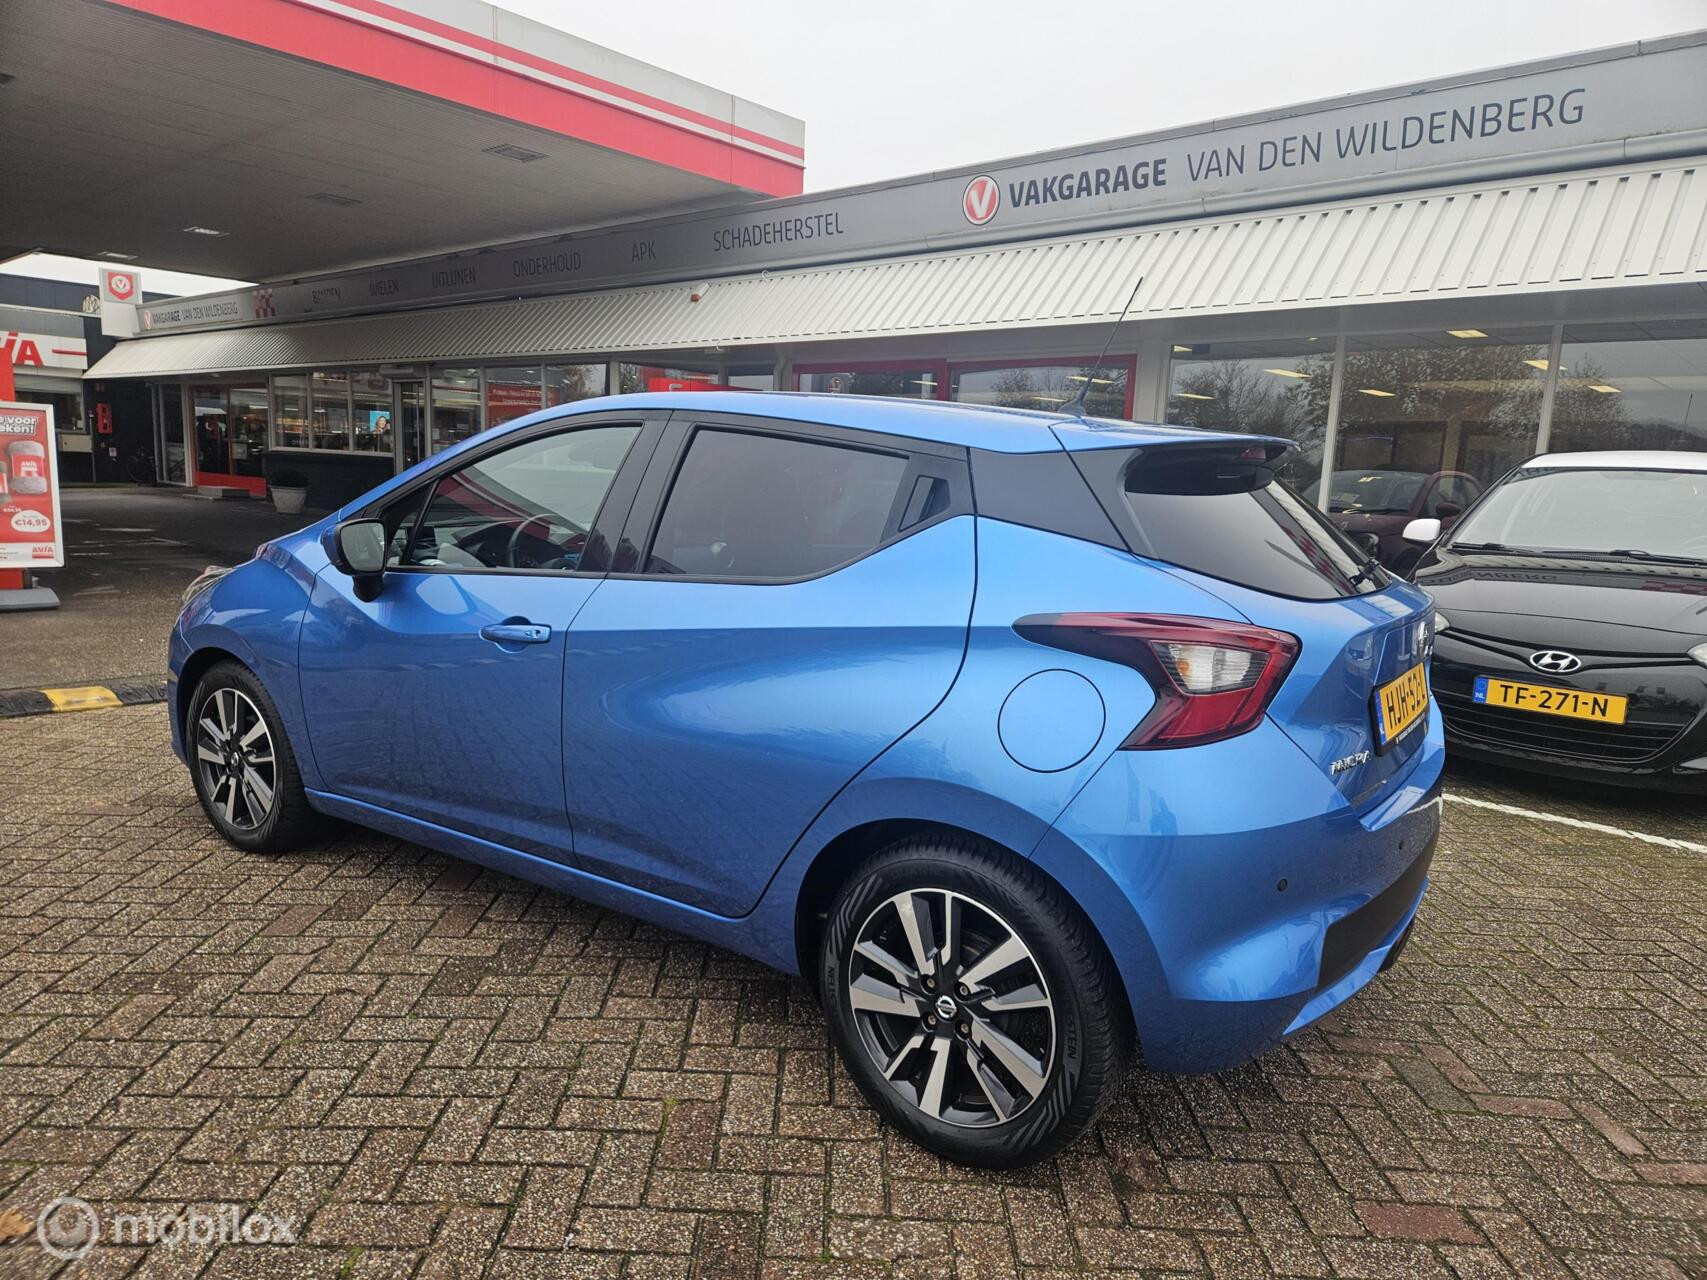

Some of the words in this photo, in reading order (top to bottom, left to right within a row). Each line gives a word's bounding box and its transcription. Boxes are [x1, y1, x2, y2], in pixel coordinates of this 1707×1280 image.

[1009, 158, 1168, 208] VAKGARAGE
[1187, 144, 1245, 182] VAN
[1258, 131, 1323, 172] DEN
[1336, 88, 1587, 159] WILDENBERG
[512, 252, 582, 278] ONDERHOUD
[631, 240, 657, 263] APK
[713, 212, 844, 251] SCHADEHERSTEL
[0, 423, 34, 434] eken!
[7, 416, 37, 425] voor
[1475, 691, 1486, 699] NL
[1500, 684, 1609, 717] TF-271-N
